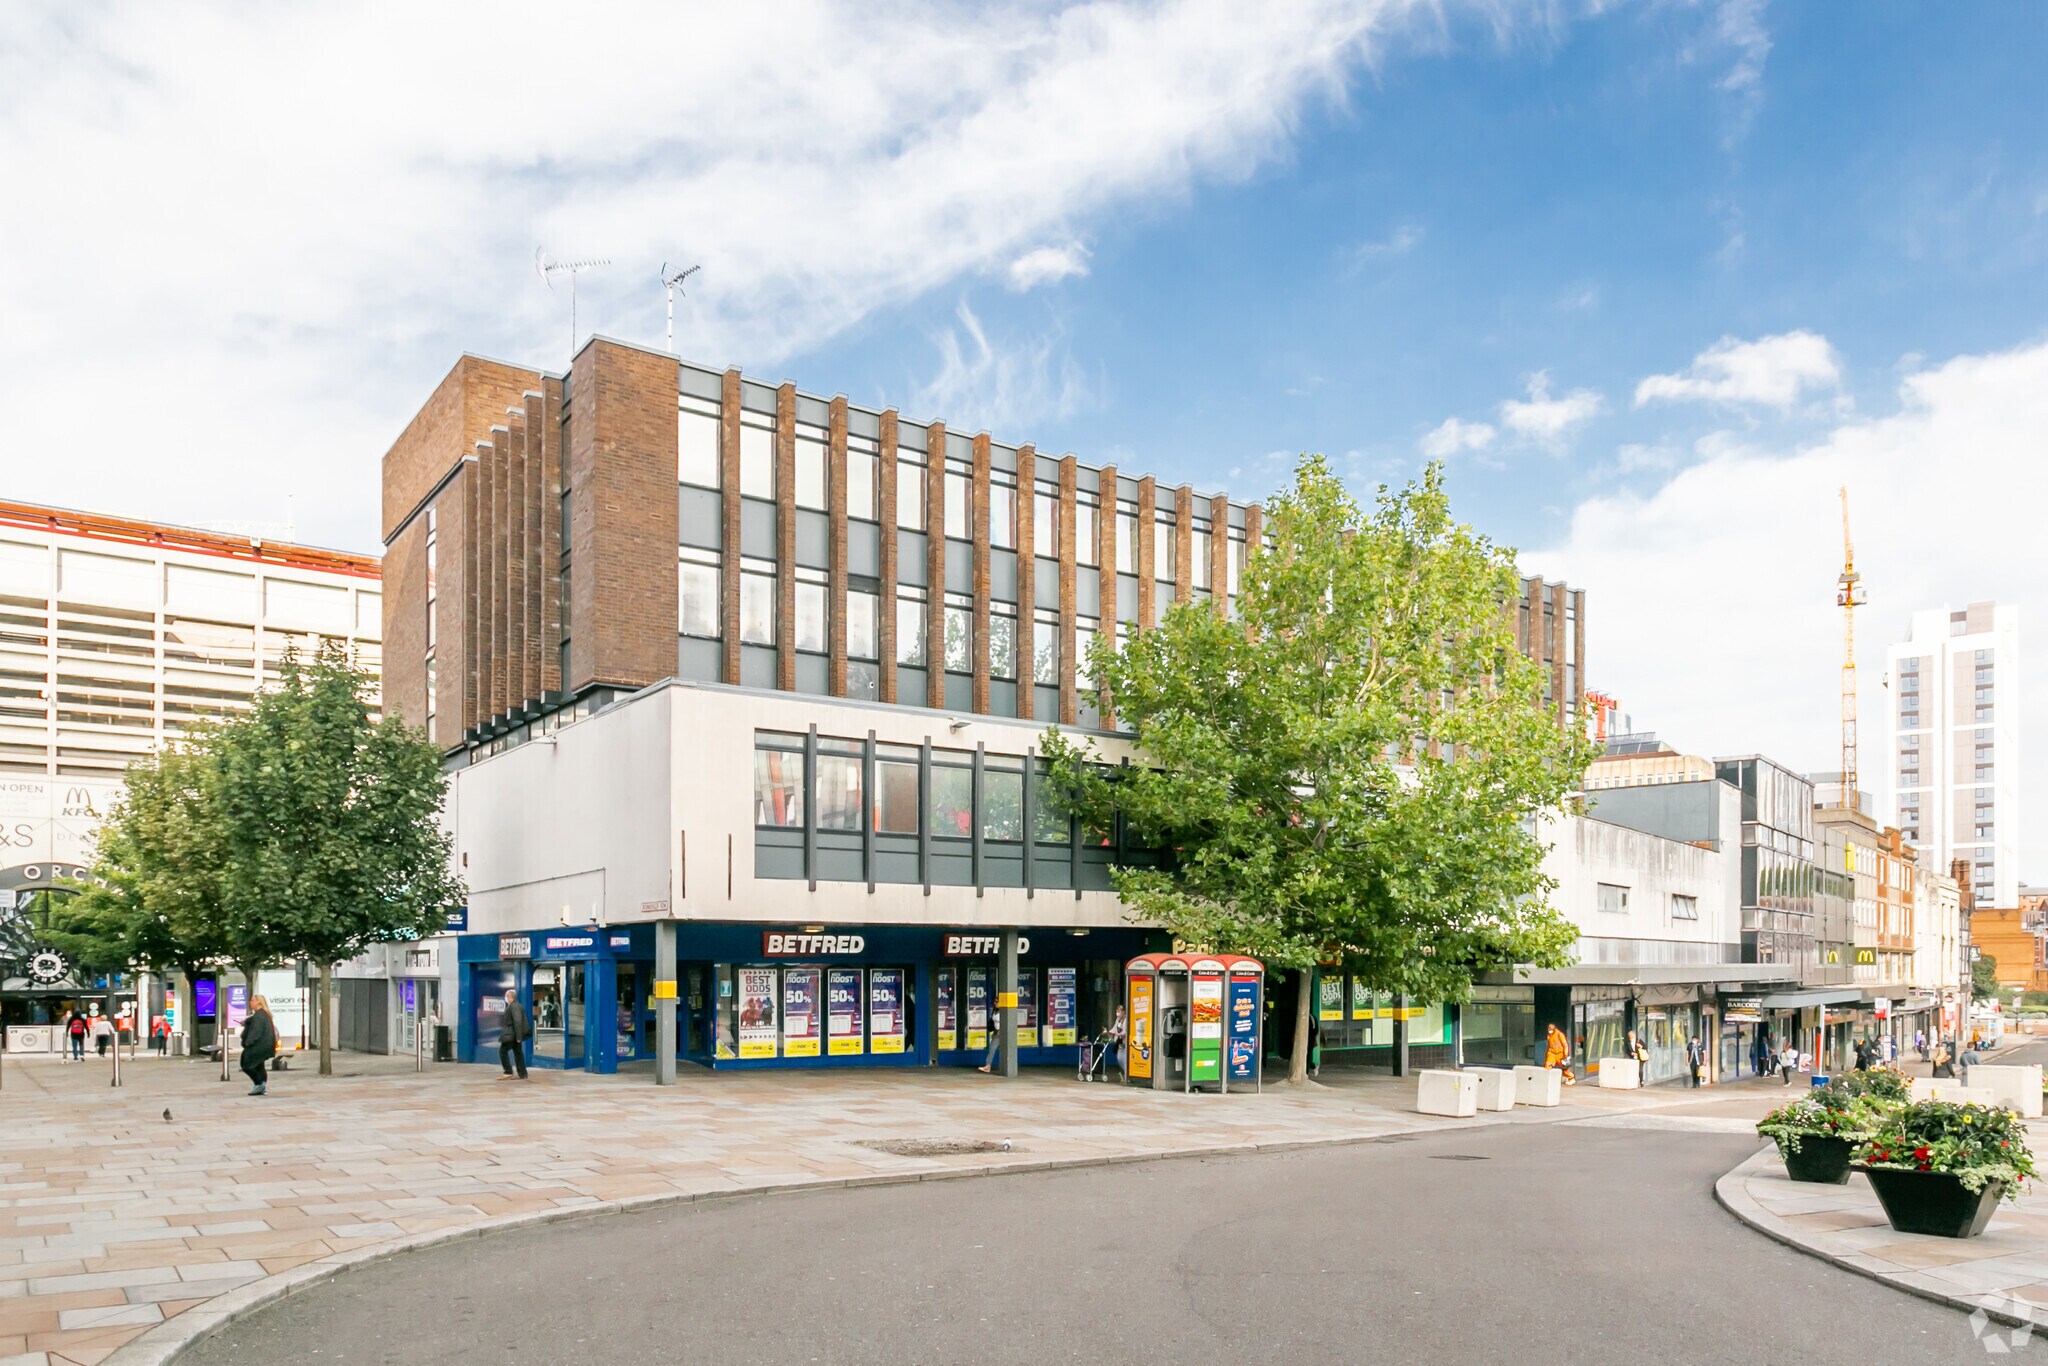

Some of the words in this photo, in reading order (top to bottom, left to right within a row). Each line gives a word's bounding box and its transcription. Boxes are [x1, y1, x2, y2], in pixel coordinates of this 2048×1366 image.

[9, 784, 43, 794] OPEN
[500, 937, 531, 955] BETFRED
[549, 938, 593, 947] BETFRED
[767, 934, 865, 954] BETFRED
[947, 936, 1030, 954] BETFD
[745, 975, 771, 985] BEST
[745, 984, 771, 993] ODDS
[969, 987, 987, 998] 50
[1321, 982, 1341, 993] BEST
[269, 996, 295, 1004] vision
[786, 990, 812, 1003] 50%
[830, 989, 855, 1002] 50%
[872, 989, 896, 1002] 50%
